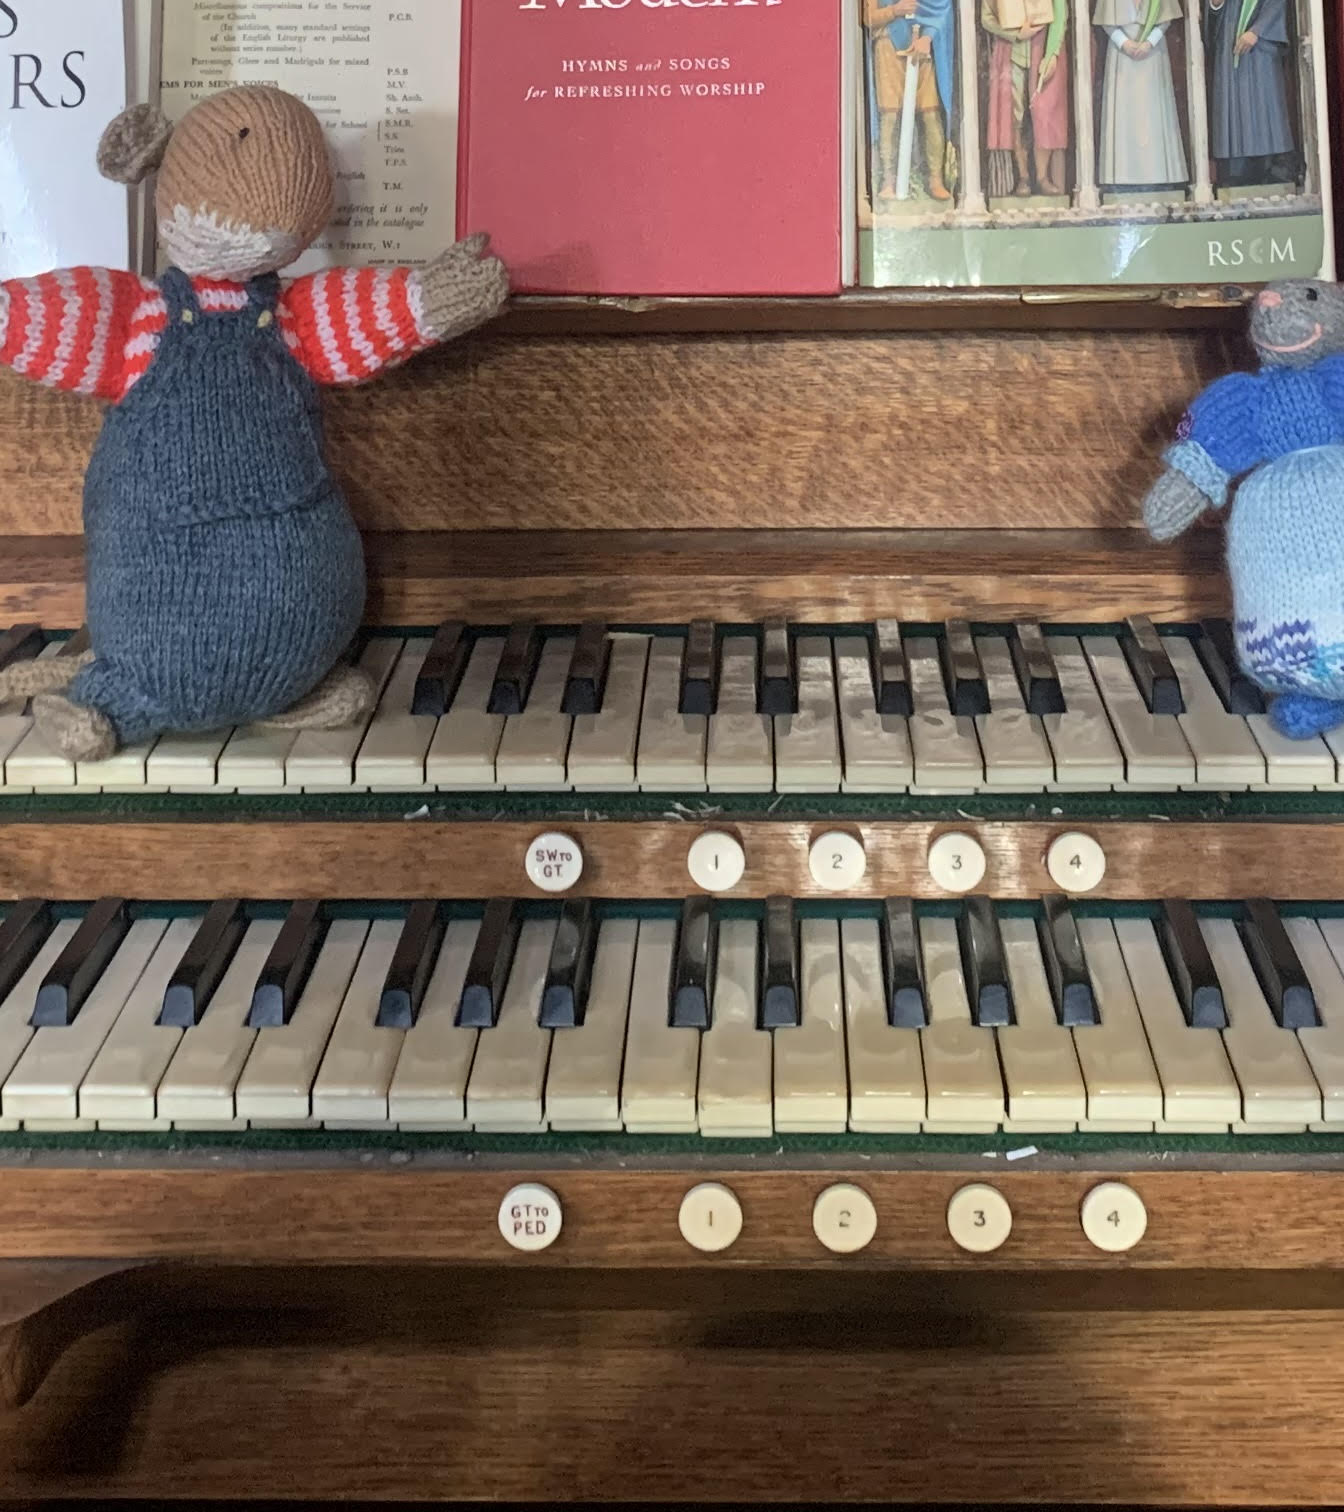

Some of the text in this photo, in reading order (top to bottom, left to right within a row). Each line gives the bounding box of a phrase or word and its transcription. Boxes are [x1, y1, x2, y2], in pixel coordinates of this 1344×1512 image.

[561, 57, 731, 73] HYMNS and SONGS
[524, 81, 766, 102] for REFRESHING WORSHIP
[535, 849, 558, 863] SW
[712, 854, 719, 870] 1
[830, 854, 844, 870] 2
[950, 854, 963, 871] 3
[1068, 854, 1082, 870] 4
[511, 1204, 533, 1219] GT
[707, 1211, 714, 1228] 1
[838, 1210, 851, 1228] 2
[973, 1210, 987, 1228] 3
[1105, 1210, 1120, 1228] 4
[513, 1220, 547, 1236] PED
